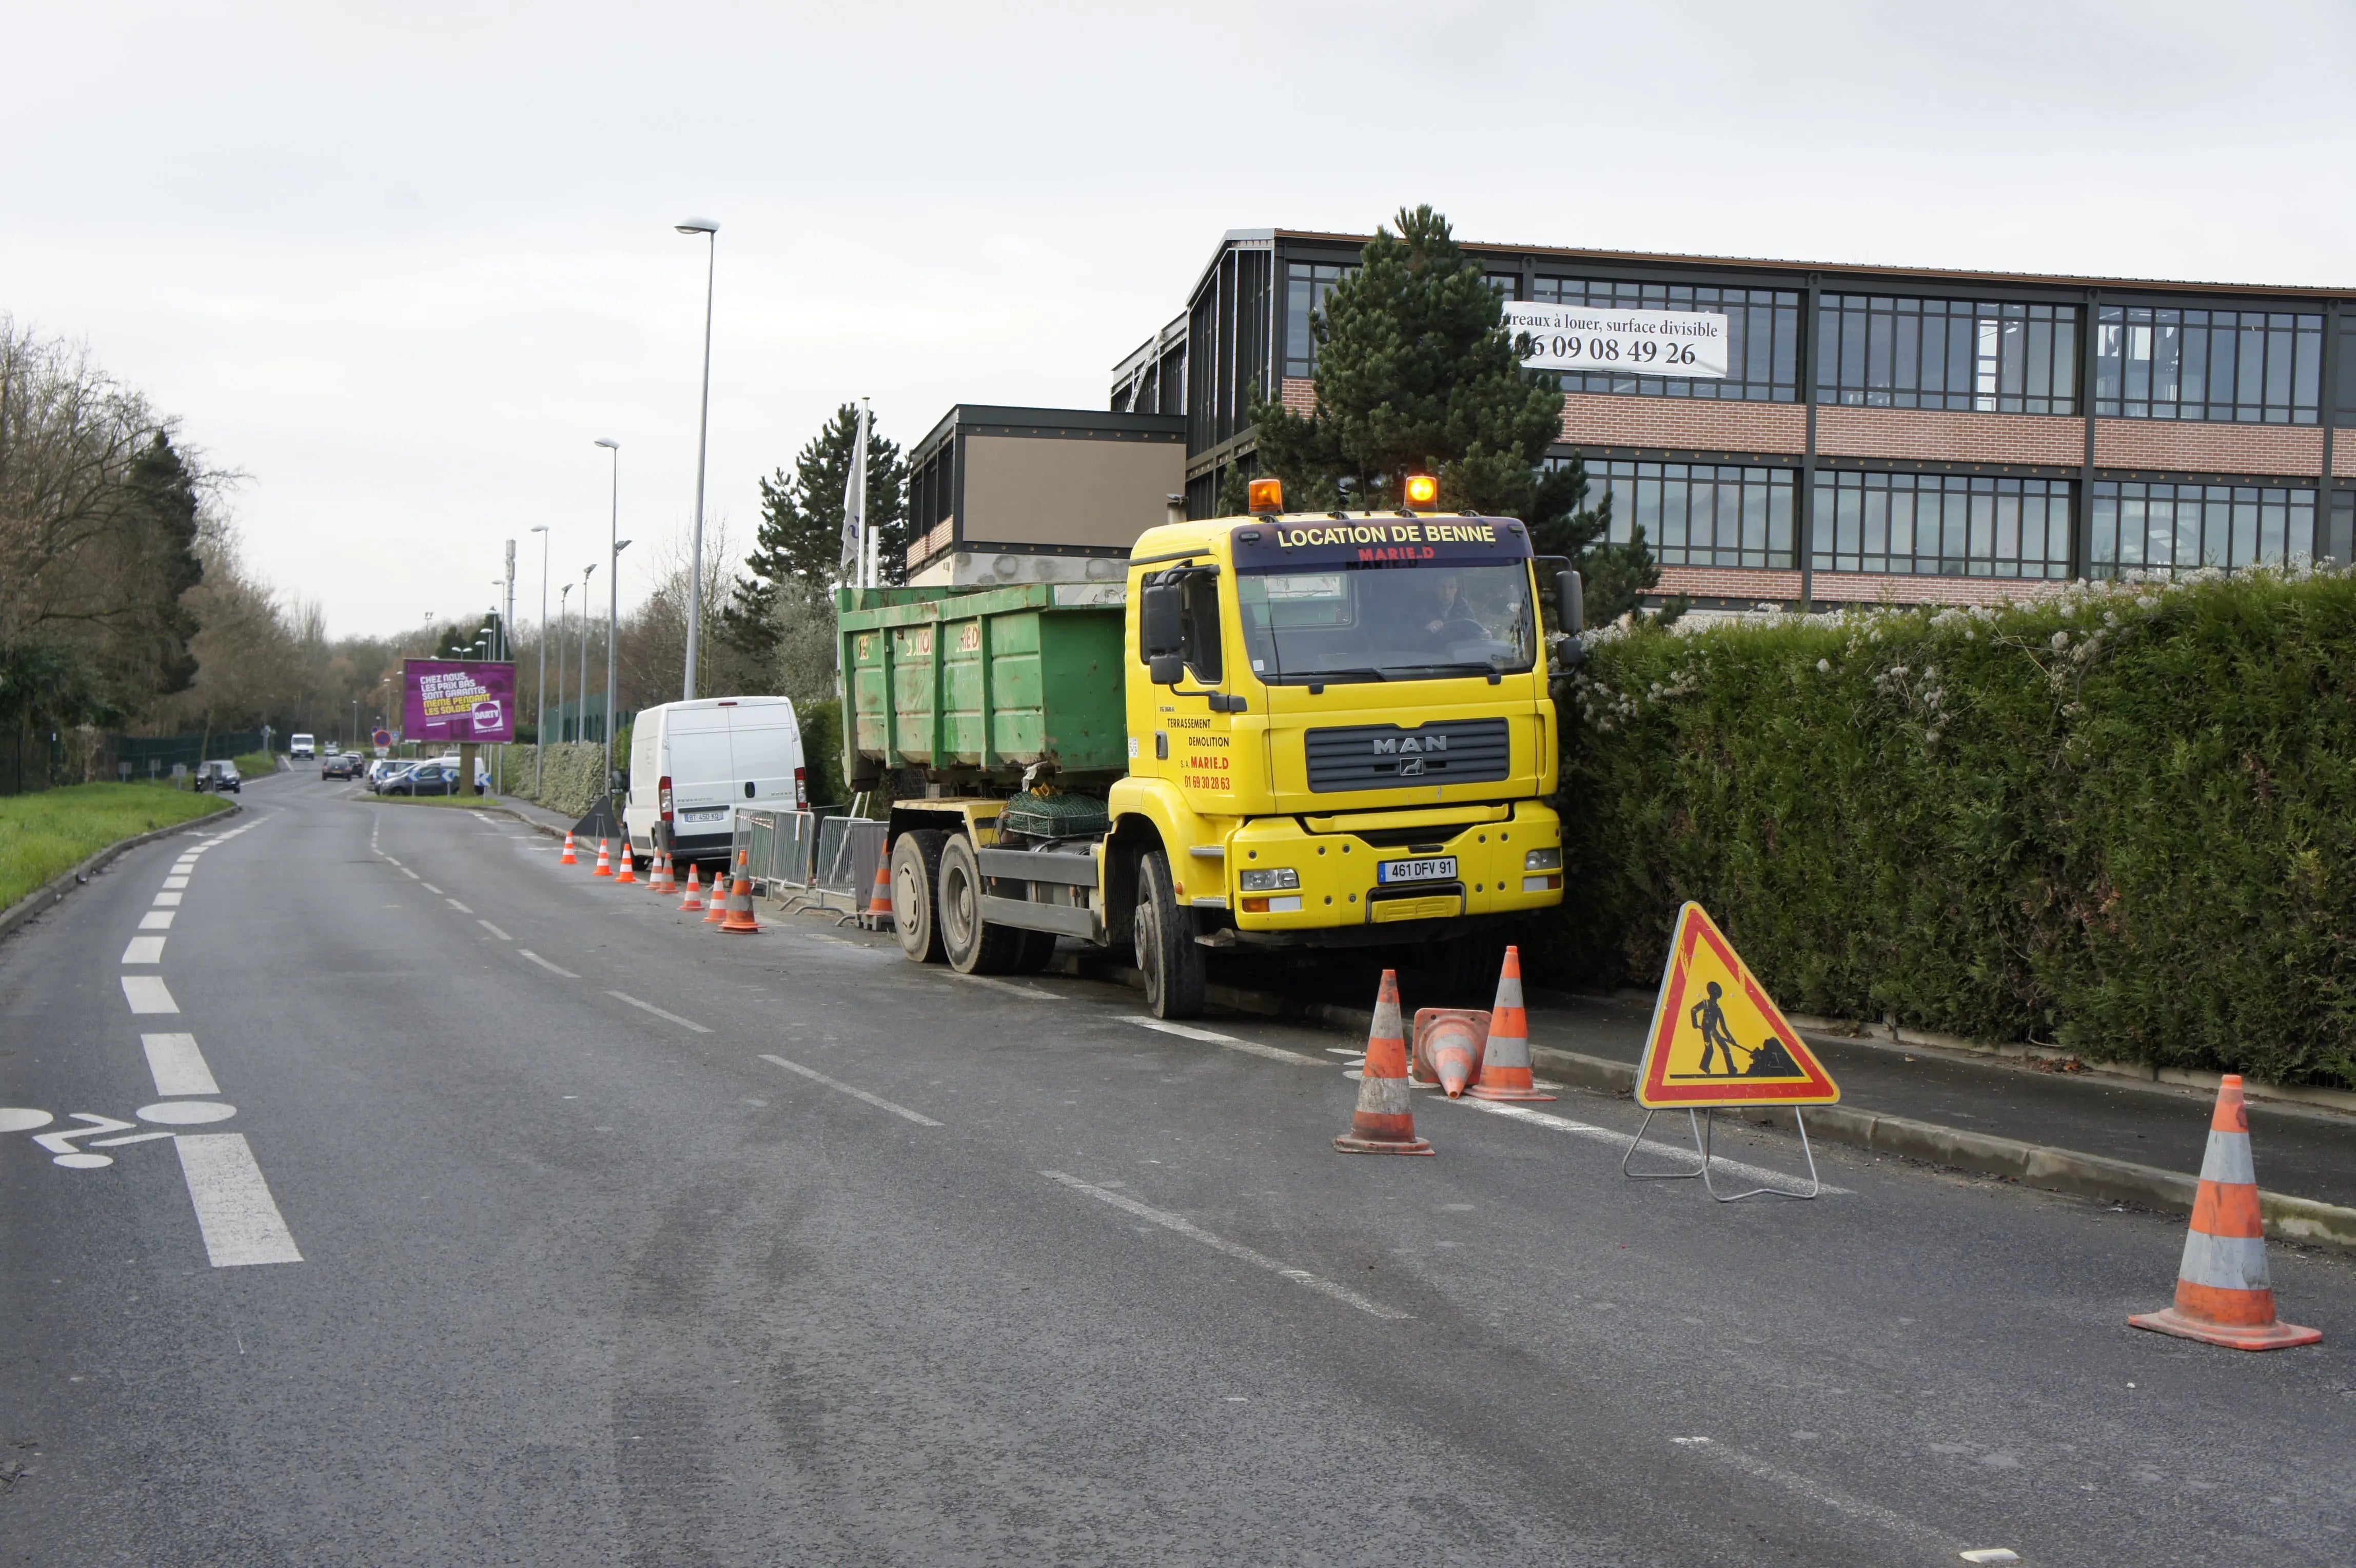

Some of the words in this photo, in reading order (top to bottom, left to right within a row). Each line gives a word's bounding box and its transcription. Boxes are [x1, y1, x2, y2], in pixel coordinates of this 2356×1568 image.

[1554, 313, 1561, 328] à
[1564, 314, 1603, 333] louer,
[1606, 318, 1656, 334] surface
[1659, 320, 1718, 338] divisible
[1552, 336, 1582, 358] 09
[1589, 338, 1619, 361] 08
[1627, 341, 1657, 363] 49
[1665, 342, 1696, 365] 26
[1277, 526, 1390, 547] LOCATION
[1392, 526, 1422, 542] DE
[1425, 526, 1496, 542] BENNE
[420, 675, 442, 684] CHEZ
[443, 672, 468, 682] NOUS,
[421, 683, 438, 692] LES
[458, 679, 476, 688] BAS
[422, 691, 444, 700] SONT
[453, 693, 490, 705] PENDANT
[424, 707, 440, 716] LES
[441, 703, 472, 714] SOLDES
[474, 710, 499, 720] DARTY
[1167, 718, 1211, 729] TERRASSEMENT
[1188, 736, 1229, 747] DEMOLITION
[1373, 735, 1447, 755] MAN
[1184, 775, 1191, 788] 01
[1192, 776, 1201, 789] 69
[1202, 776, 1209, 789] 30
[1211, 776, 1219, 790] 28
[1221, 777, 1230, 790] 63
[1392, 864, 1410, 877] 461
[1415, 861, 1435, 876] DFV
[1439, 860, 1451, 874] 91
